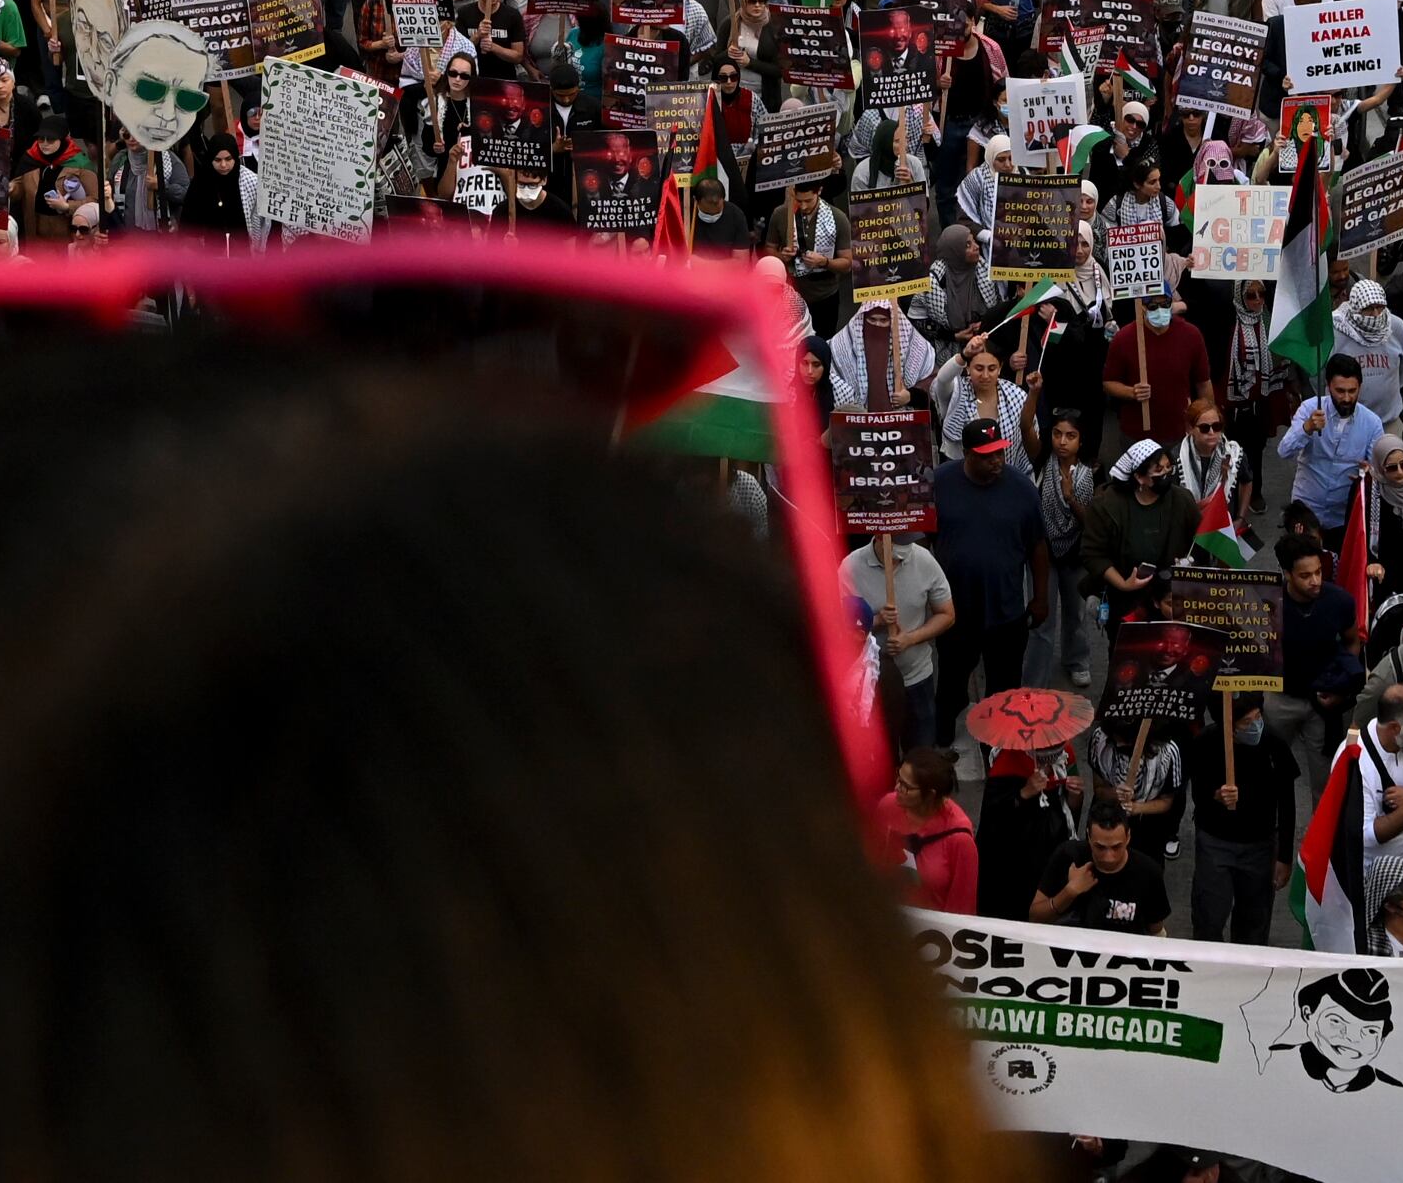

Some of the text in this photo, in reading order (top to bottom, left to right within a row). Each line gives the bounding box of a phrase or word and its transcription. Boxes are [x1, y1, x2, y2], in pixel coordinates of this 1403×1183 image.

[398, 17, 436, 25] AID TO
[1319, 8, 1364, 25] KILLER
[400, 26, 438, 35] ISRAEL!
[1311, 25, 1370, 43] KAMALA
[1193, 38, 1258, 60] LEGACY:
[1322, 43, 1361, 58] WE'RE
[1190, 53, 1256, 72] THE BUTCHER
[1306, 58, 1381, 77] SPEAKING!
[874, 71, 927, 83] DEMOCRATS
[1187, 64, 1253, 88] OF GAZA
[871, 87, 916, 98] GENOCIDE
[880, 82, 902, 90] FUND
[869, 91, 932, 104] PALESTINIANS
[1023, 95, 1074, 107] SHUT THE
[316, 199, 342, 213] LOVE
[1005, 203, 1062, 212] DEMOCRATS
[1235, 190, 1289, 215] THE
[267, 206, 360, 242] LET IT BE A STORY
[1005, 216, 1069, 224] REPUBLICANS
[1061, 229, 1074, 237] ON
[1108, 224, 1159, 238] STAND WITH
[1211, 217, 1287, 244] GREA
[1005, 240, 1067, 249] THEIR HANDS!
[1109, 232, 1159, 245] PALESTINE!
[1112, 248, 1136, 259] END
[1193, 247, 1281, 271] DECEPT
[1113, 257, 1159, 272] AID TO
[1113, 270, 1160, 284] ISRAEL!
[846, 414, 914, 424] FREE PALESTINE
[861, 431, 902, 441] END
[849, 445, 915, 456] U.S. AID
[870, 461, 895, 471] TO
[850, 475, 919, 486] ISRAEL
[1055, 1012, 1183, 1047] BRIGADE
